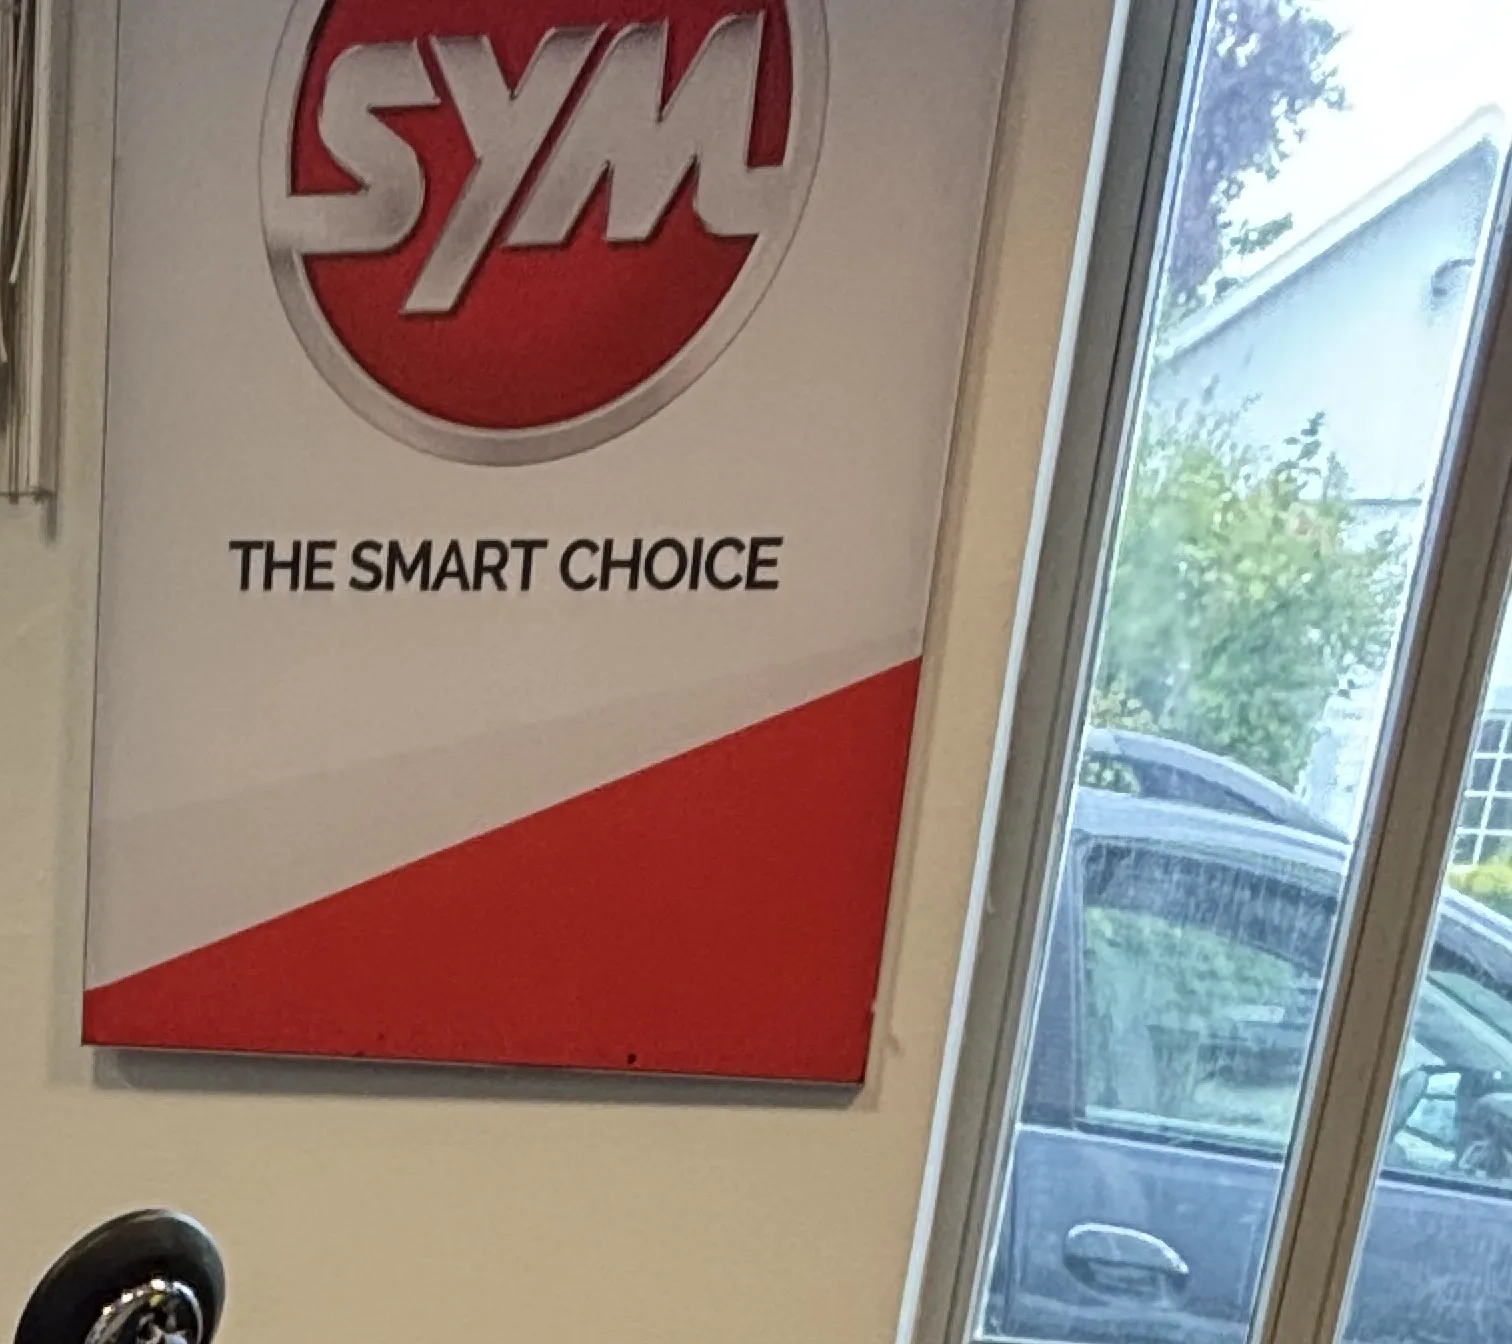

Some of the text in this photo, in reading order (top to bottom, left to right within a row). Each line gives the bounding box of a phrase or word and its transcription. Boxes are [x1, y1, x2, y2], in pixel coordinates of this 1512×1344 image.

[287, 12, 785, 316] SYM
[229, 536, 785, 593] THE SMART CHOICE
